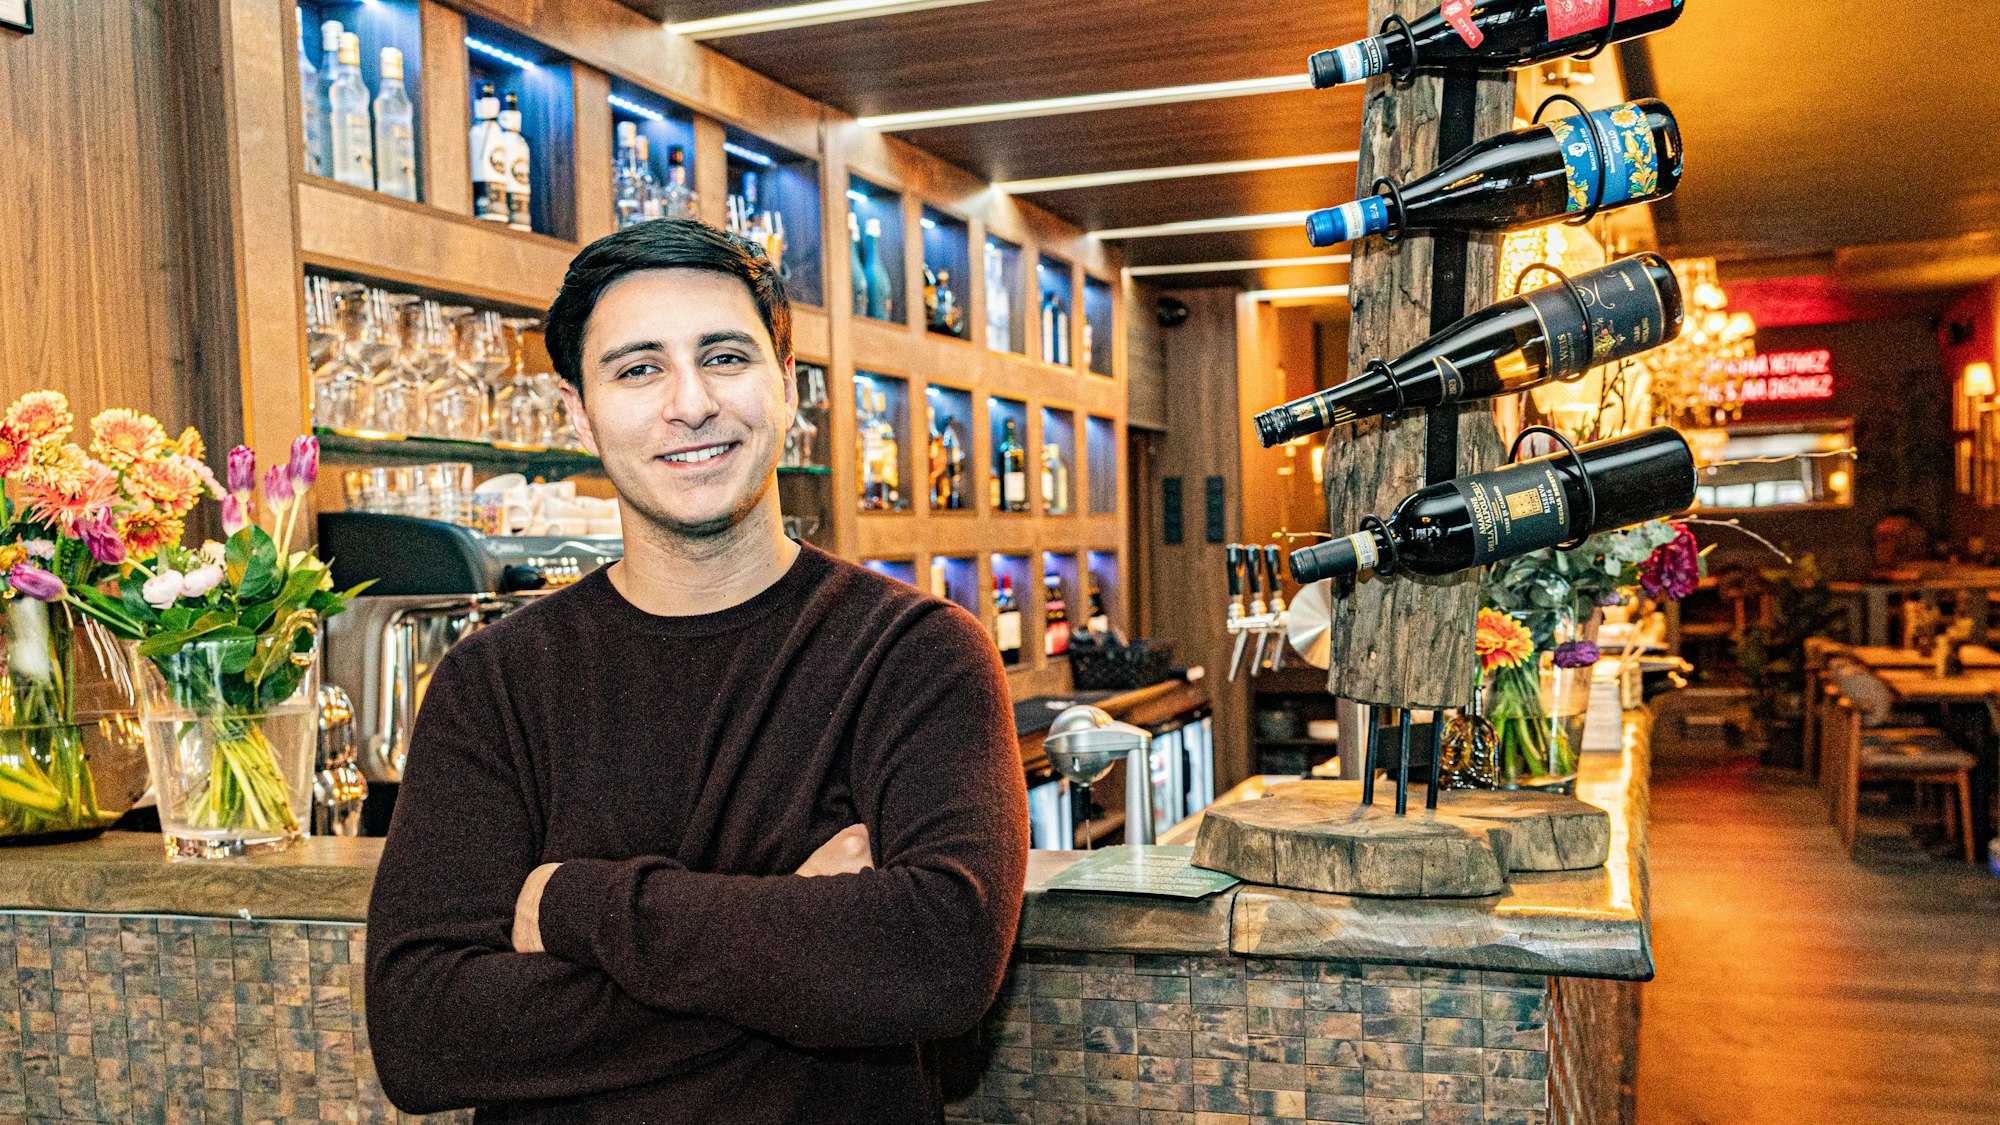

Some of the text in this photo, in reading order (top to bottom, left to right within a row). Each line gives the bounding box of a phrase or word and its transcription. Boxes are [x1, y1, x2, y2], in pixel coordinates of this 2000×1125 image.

[1608, 130, 1621, 153] GRILLO
[1537, 483, 1551, 514] RISERVA
[1545, 469, 1565, 525] CECILIA BERETTA
[1546, 489, 1556, 505] 2016
[1469, 481, 1495, 552] DELLA VALPOLICELLA
[1470, 496, 1487, 535] AMARONE
